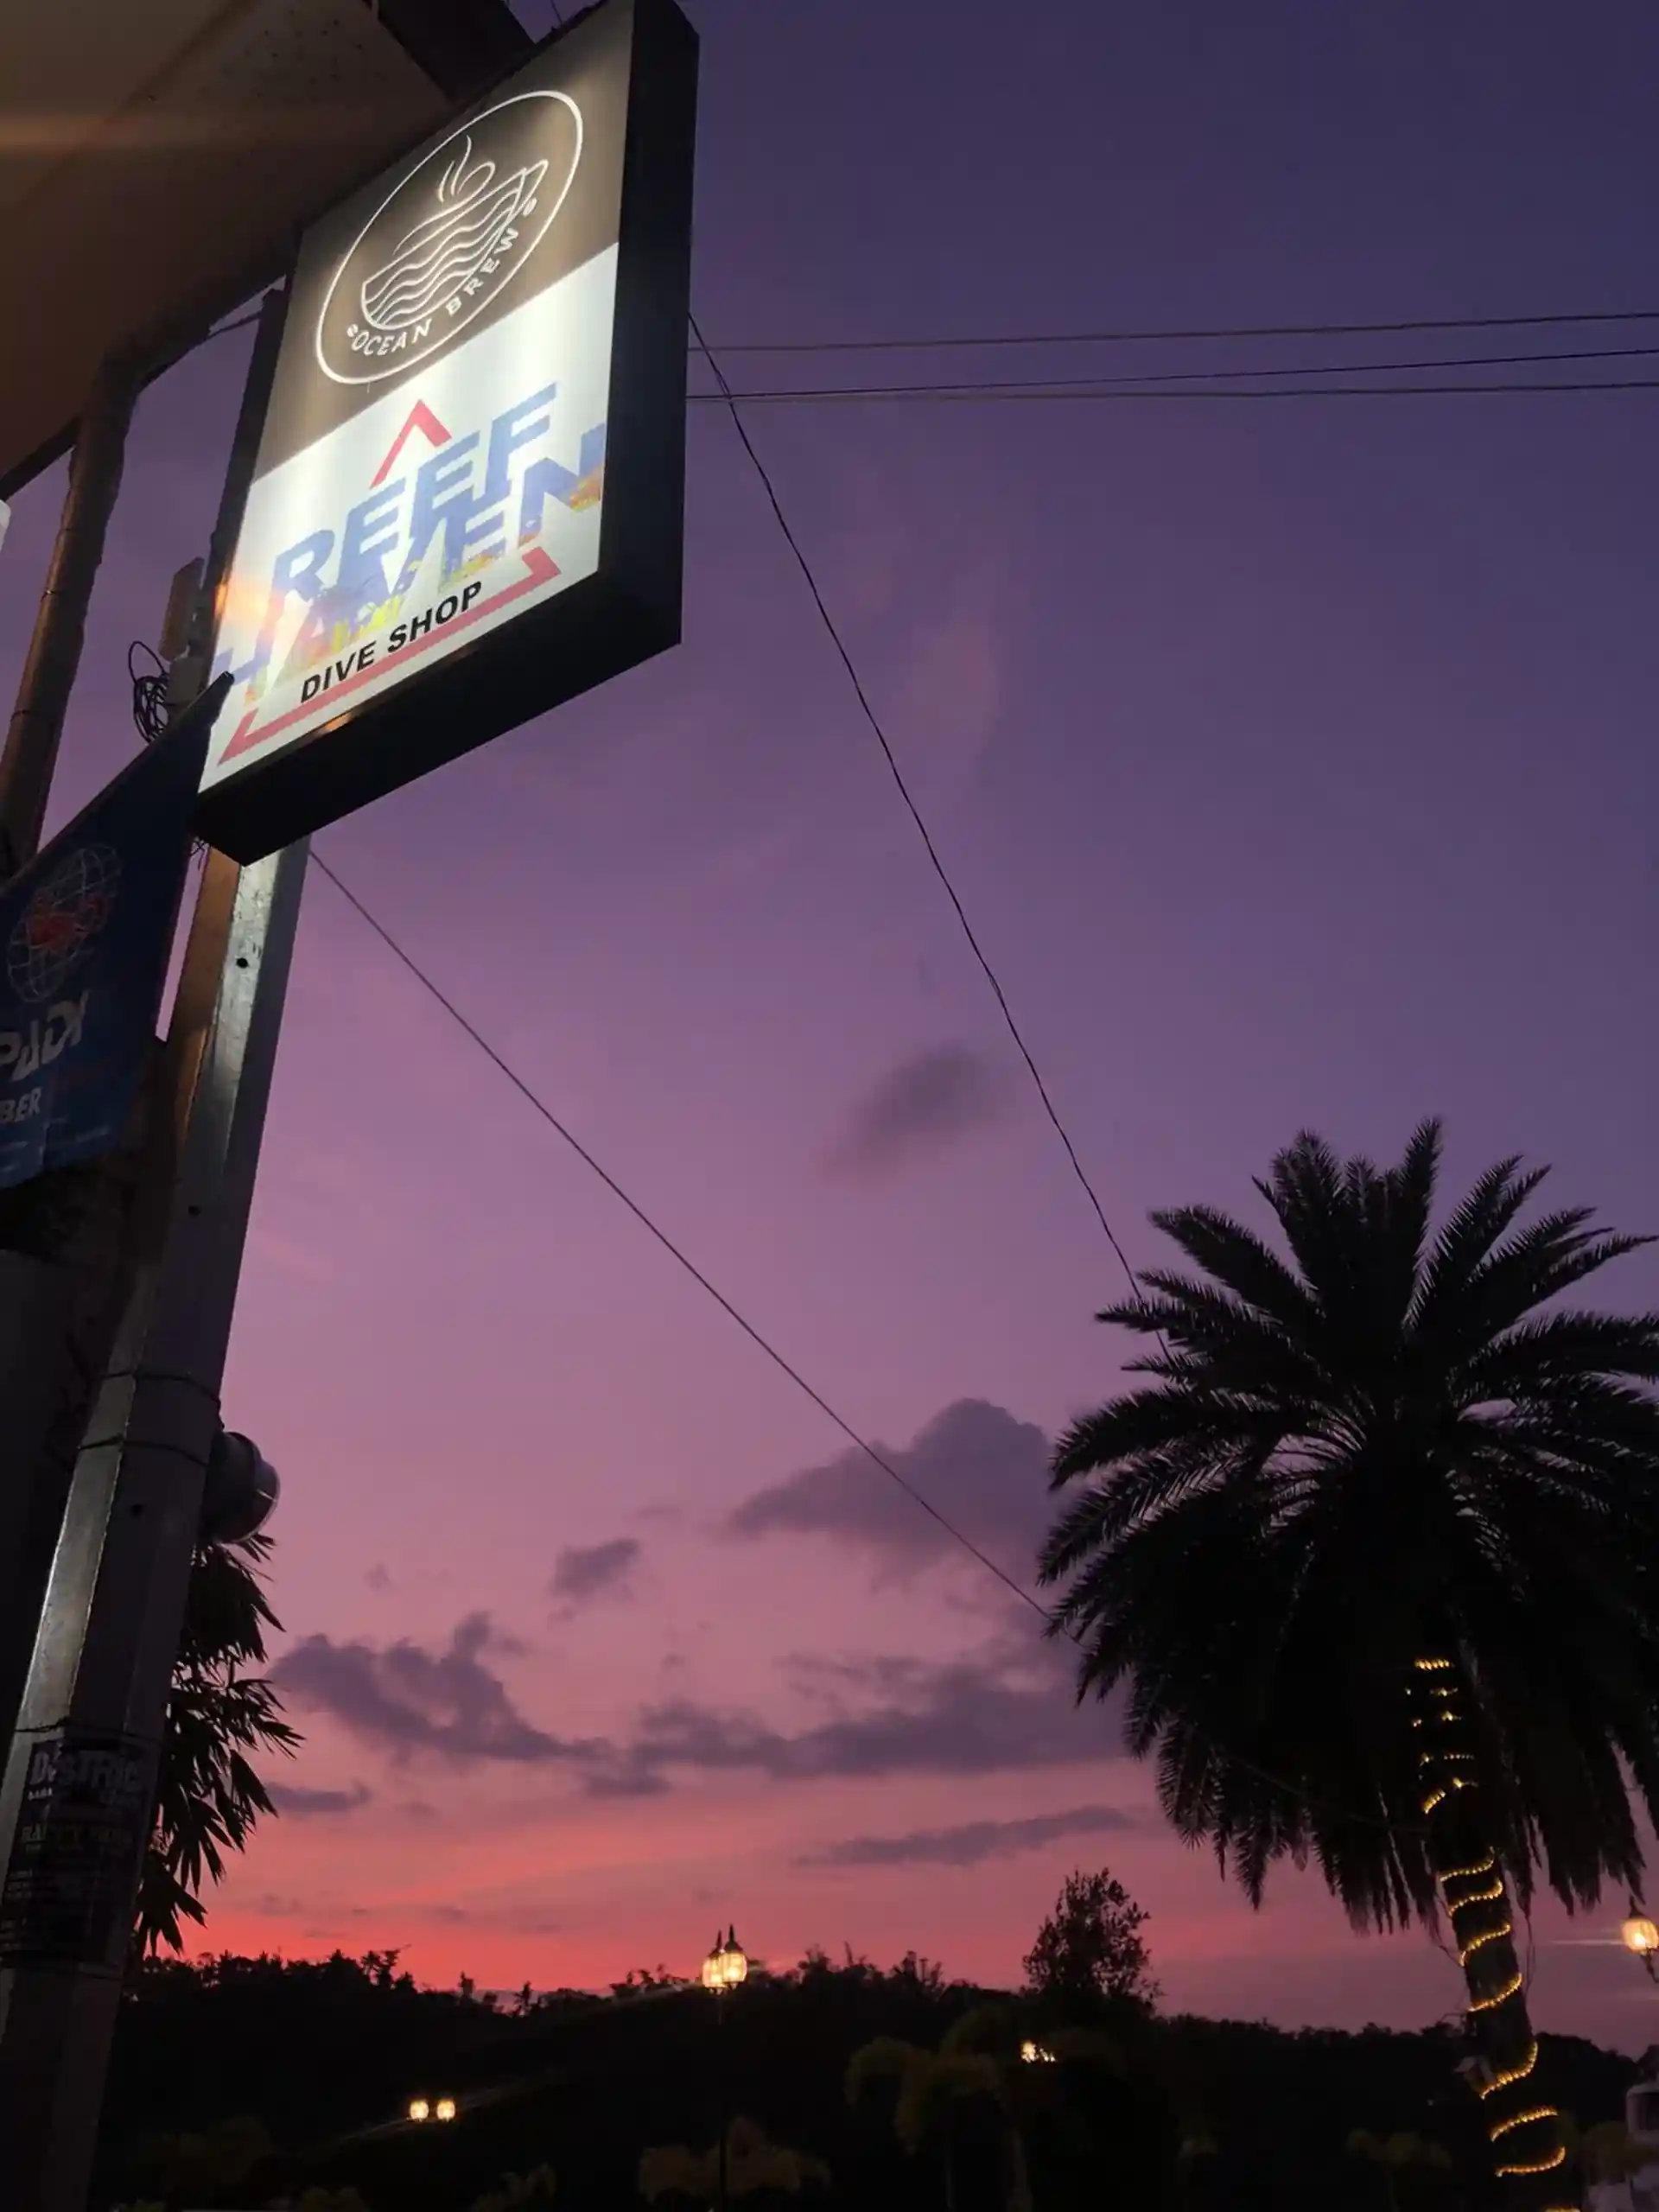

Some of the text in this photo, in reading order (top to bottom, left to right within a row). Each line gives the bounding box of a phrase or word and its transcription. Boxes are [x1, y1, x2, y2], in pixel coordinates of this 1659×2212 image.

[351, 227, 519, 356] OCEAN BREW
[213, 423, 605, 705] HAVEN
[270, 381, 557, 602] REEF
[300, 581, 483, 704] DIVE SHOP
